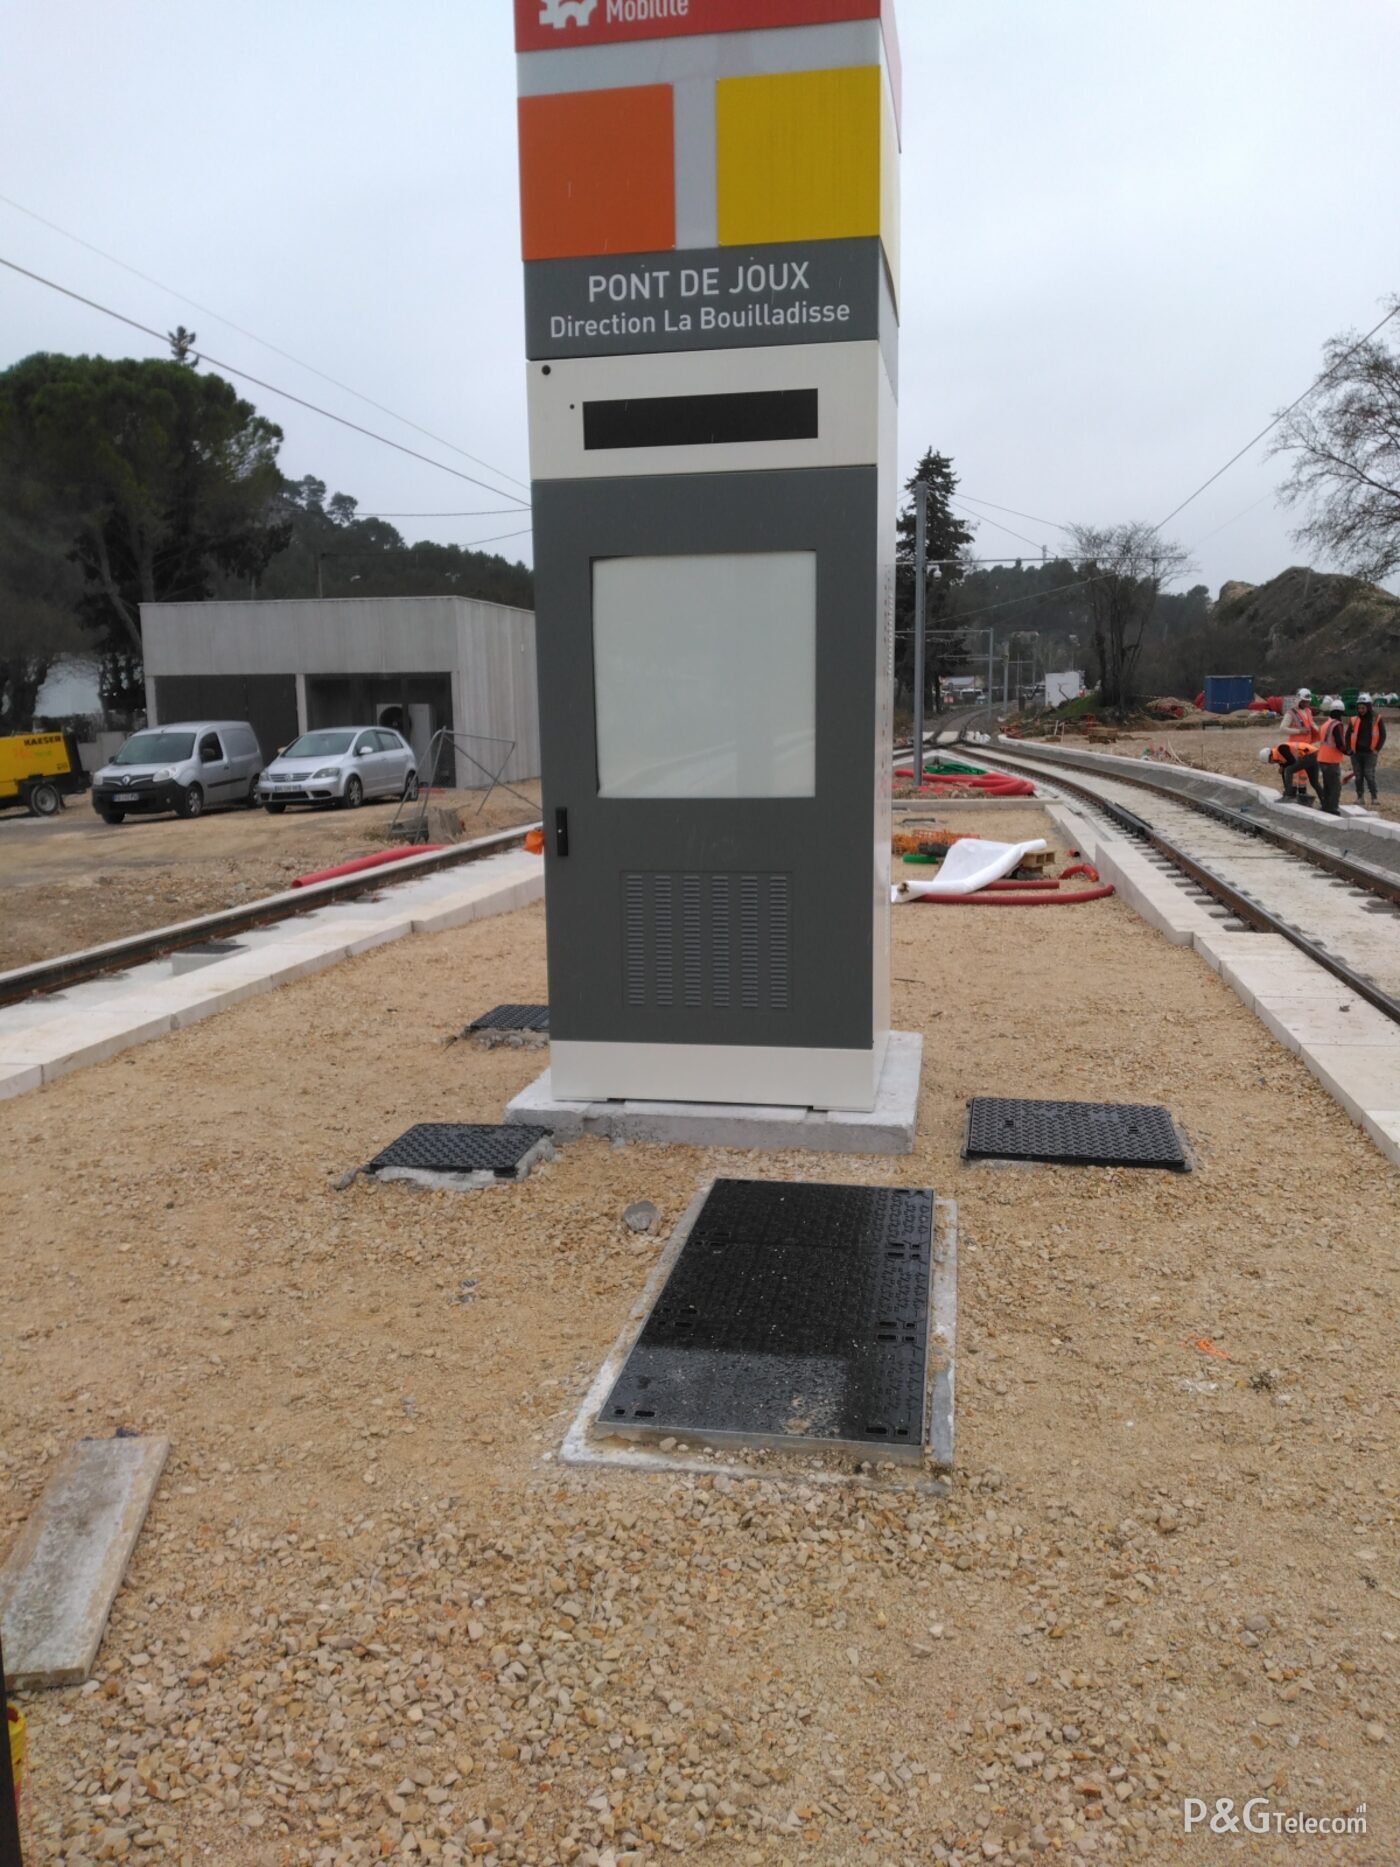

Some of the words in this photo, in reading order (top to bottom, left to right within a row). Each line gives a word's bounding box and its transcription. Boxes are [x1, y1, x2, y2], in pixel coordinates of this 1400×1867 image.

[588, 270, 670, 303] PONT
[679, 267, 720, 298] DE
[728, 261, 810, 294] JOUX
[550, 308, 656, 338] Direction
[663, 310, 692, 333] La
[699, 301, 851, 331] Bouilladisse
